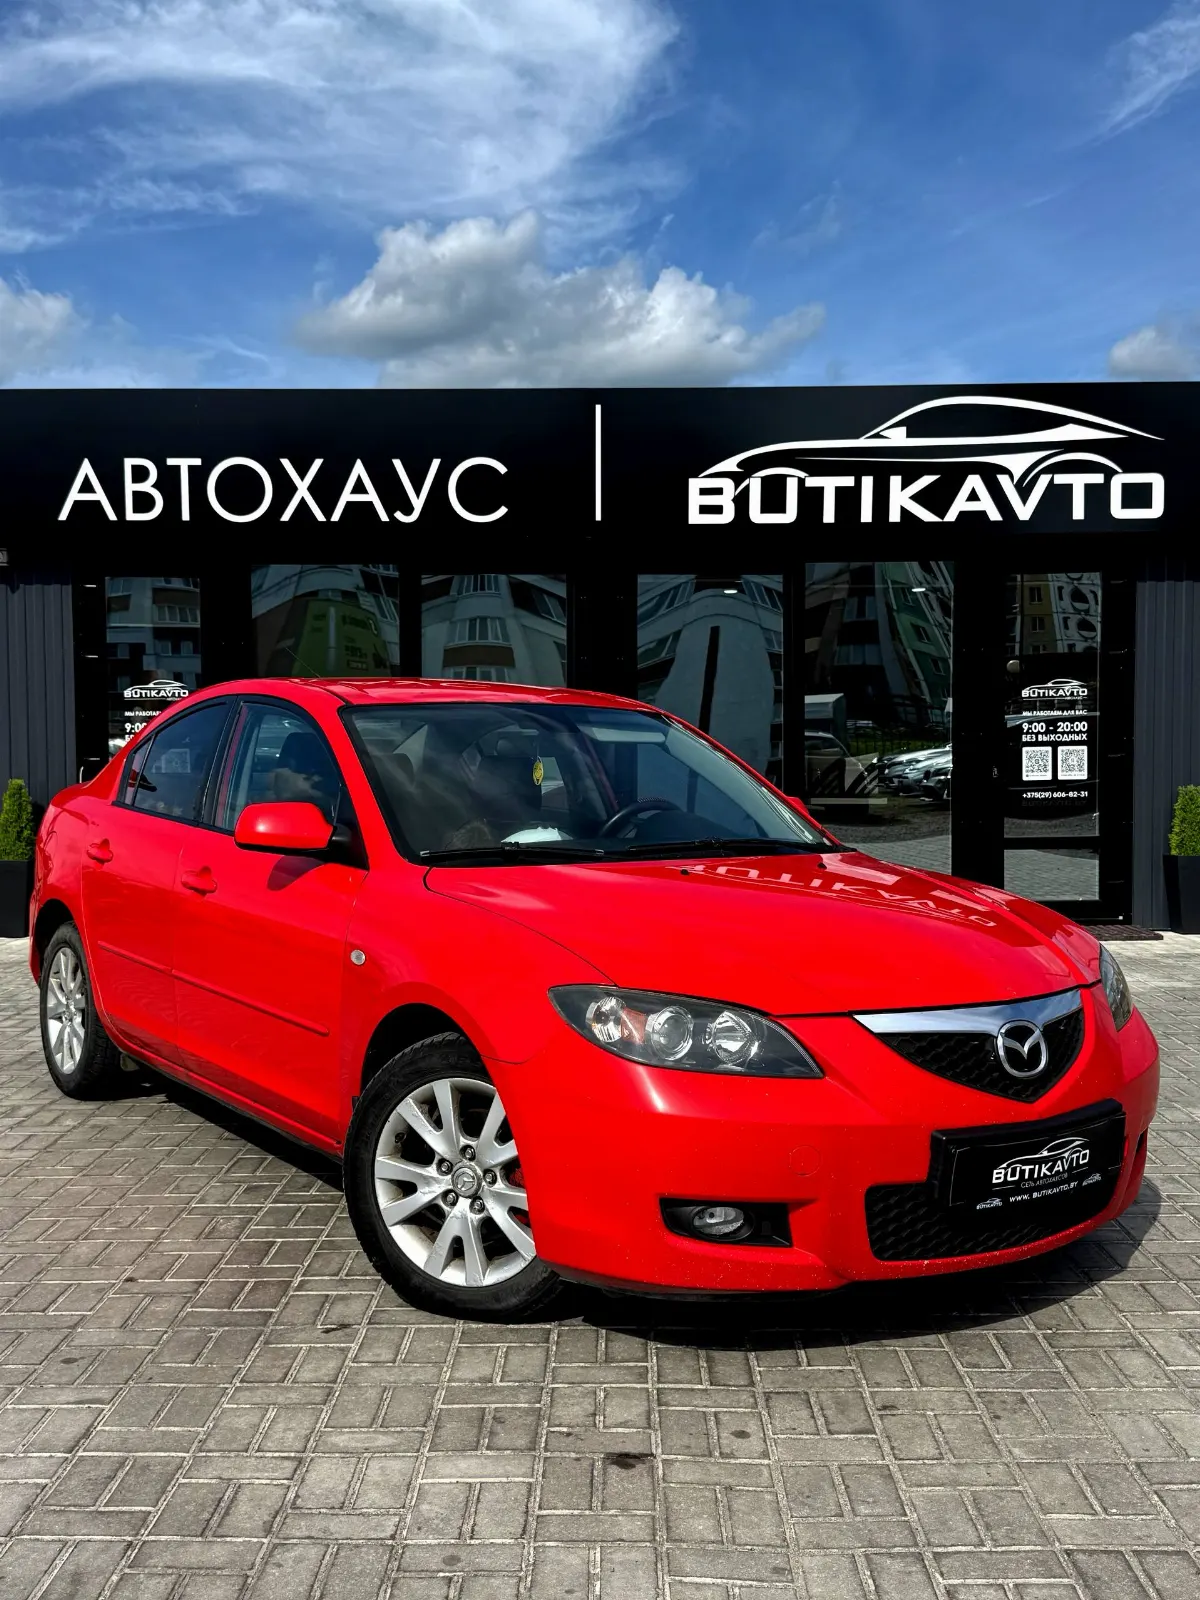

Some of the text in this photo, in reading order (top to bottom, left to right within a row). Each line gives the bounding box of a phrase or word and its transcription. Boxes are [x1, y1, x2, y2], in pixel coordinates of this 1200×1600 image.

[58, 456, 509, 524] АВТОХАУС
[688, 471, 1165, 525] BUTIKAVTO
[123, 689, 189, 698] BUTIKAVTO
[1021, 688, 1088, 698] BUTIKAVTO
[1022, 722, 1046, 733] 9:00
[1056, 721, 1088, 732] 20:00
[1022, 733, 1088, 742] БЕЗ ВЫХОДНЫХ
[1022, 790, 1089, 799] +375(29) 606-82-31
[992, 1149, 1090, 1184] BUTIKAVTO
